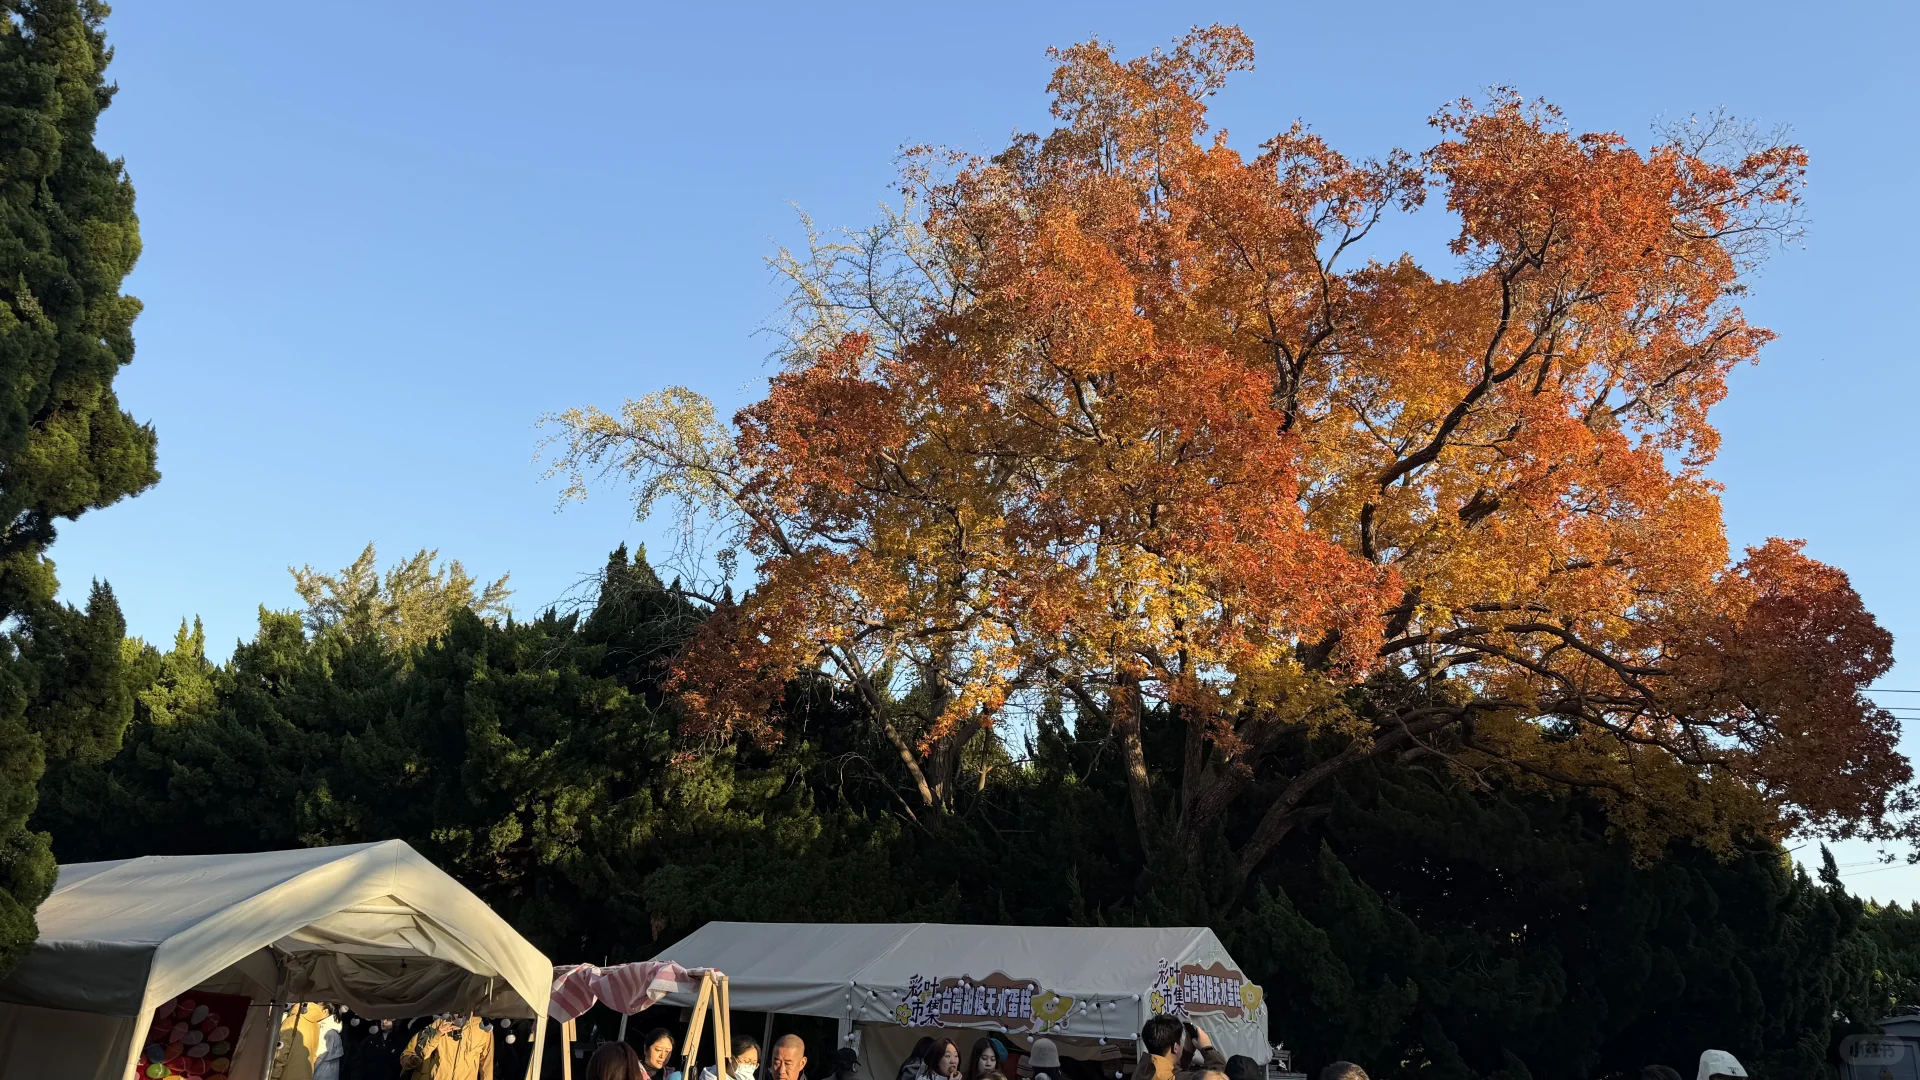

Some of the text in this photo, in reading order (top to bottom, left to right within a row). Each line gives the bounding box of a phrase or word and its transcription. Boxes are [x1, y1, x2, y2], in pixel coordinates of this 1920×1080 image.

[902, 973, 939, 1002] 彩叶
[1154, 959, 1181, 988] 彩叶
[911, 999, 944, 1027] 市集
[941, 986, 1032, 1019] 台湾甜橙无水蛋糕
[1163, 986, 1188, 1016] 市集
